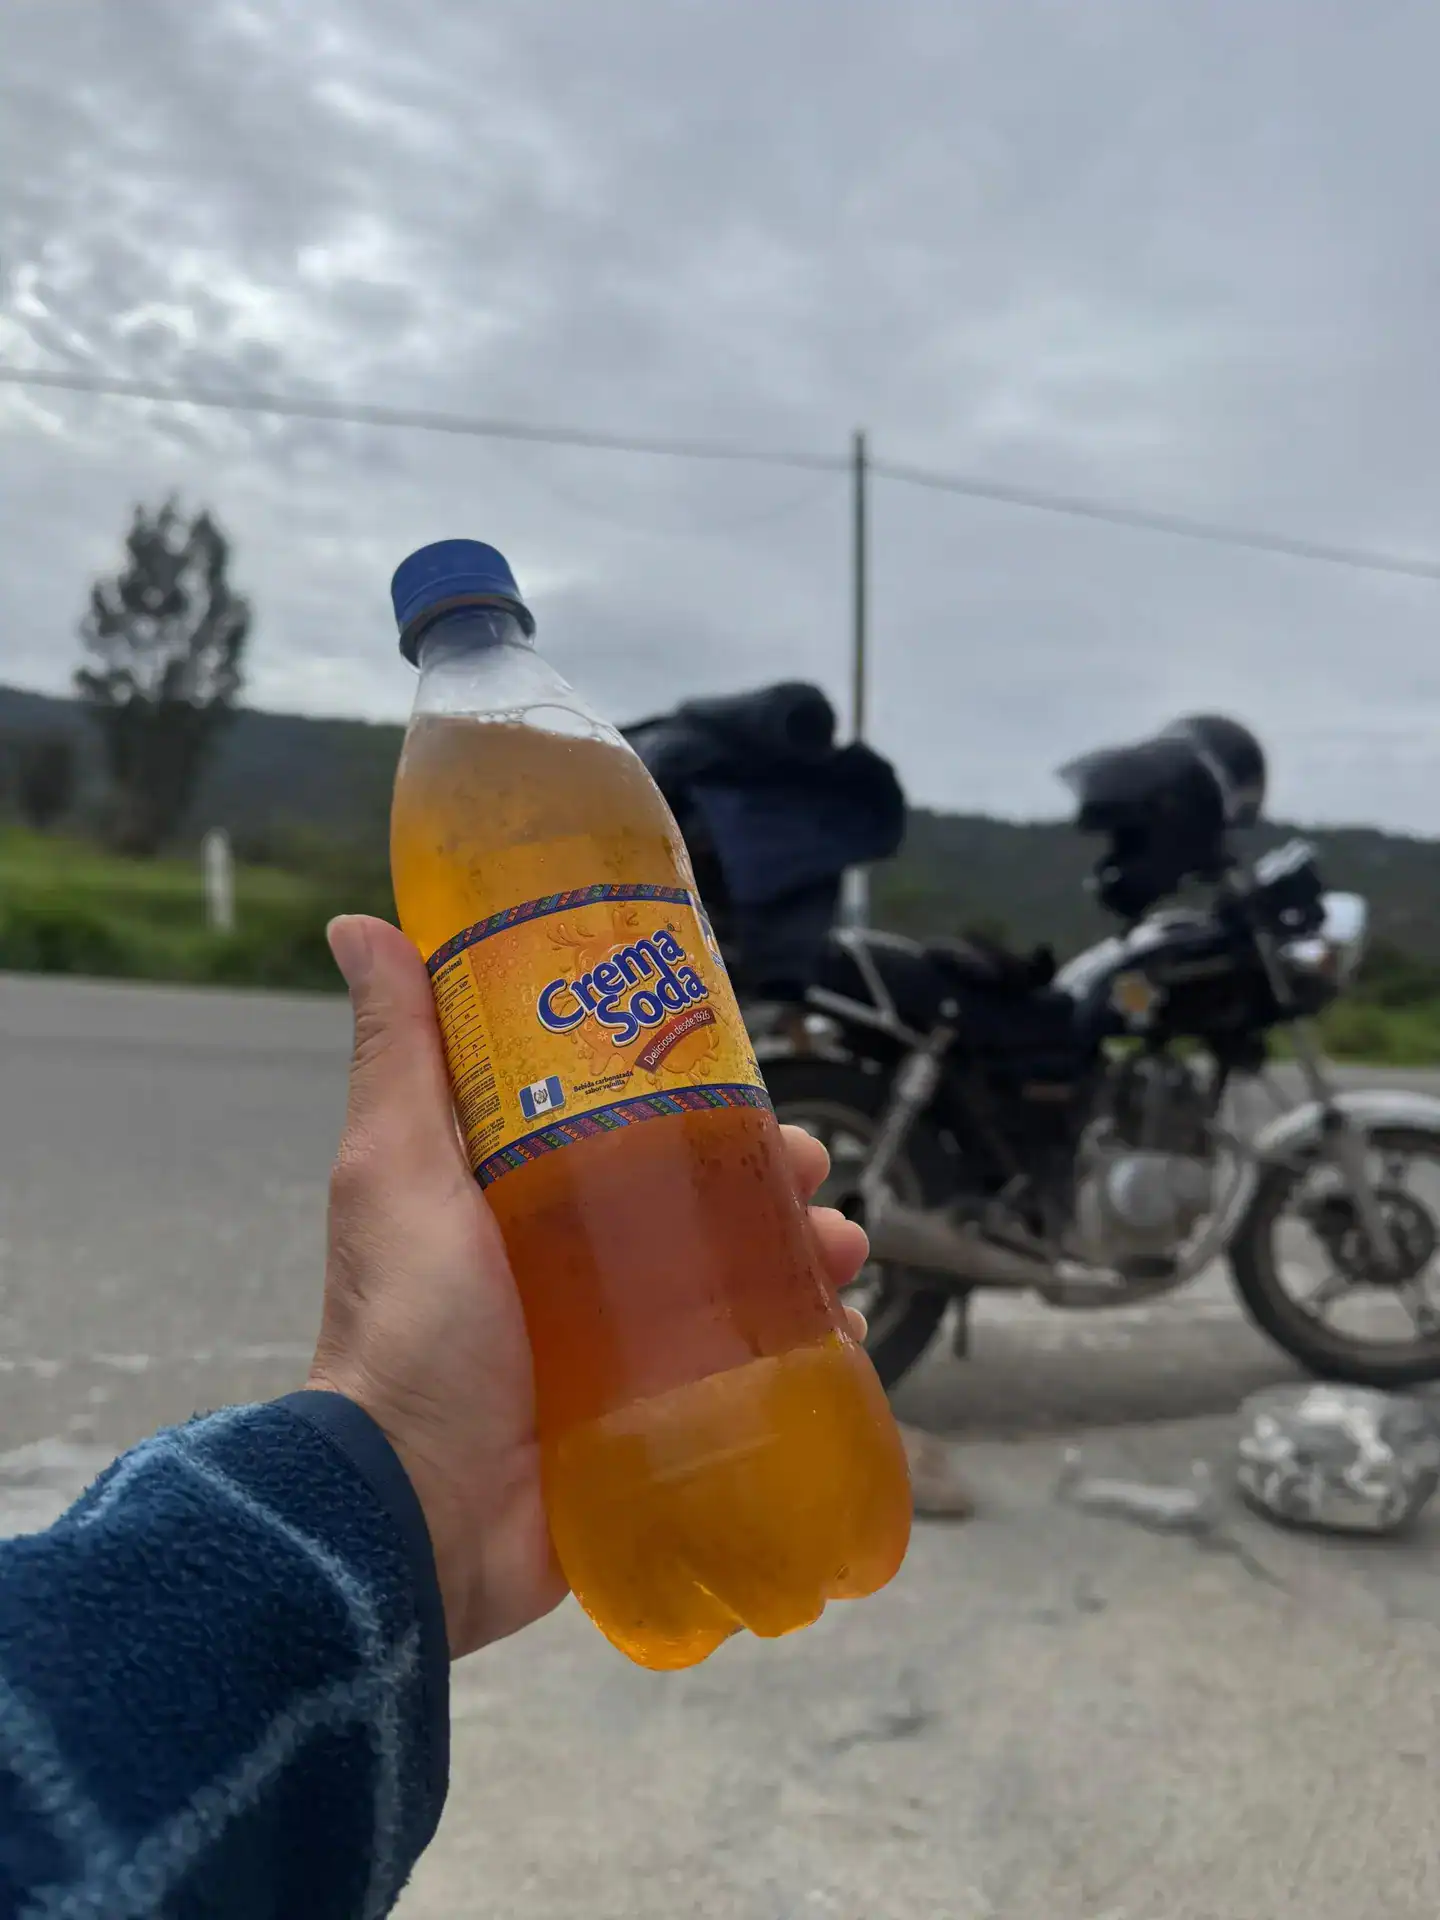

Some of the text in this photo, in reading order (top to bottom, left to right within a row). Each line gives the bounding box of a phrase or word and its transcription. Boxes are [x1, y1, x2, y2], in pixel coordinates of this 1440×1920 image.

[537, 928, 687, 1032] Crema
[594, 964, 709, 1048] Soda
[674, 1016, 696, 1035] desde
[693, 1010, 711, 1022] 1926
[573, 1070, 634, 1092] Bebida carbonatada
[584, 1086, 603, 1095] sabor
